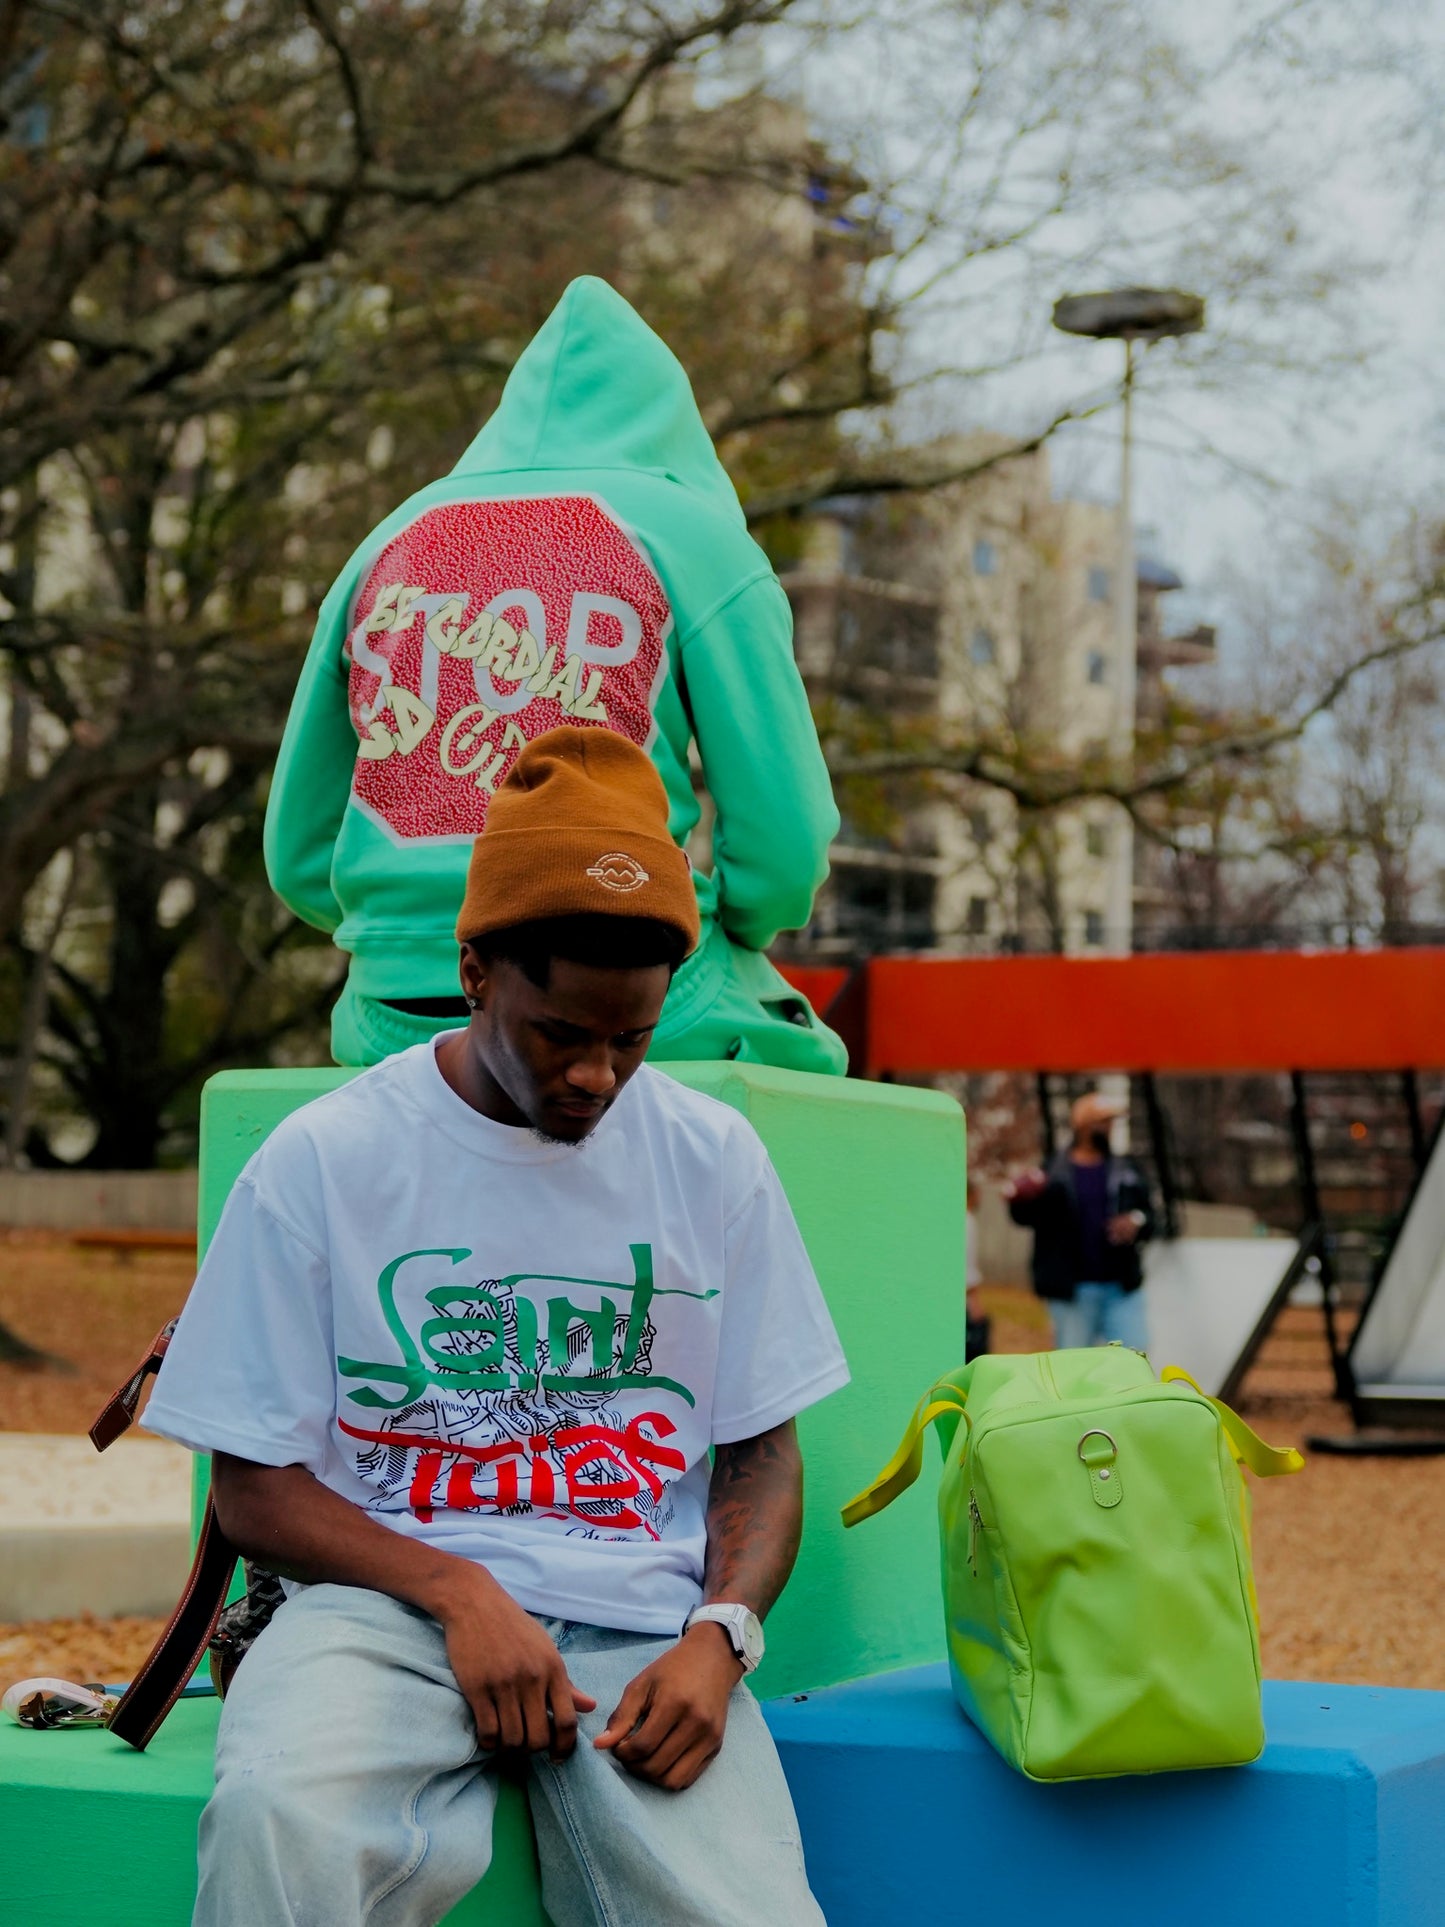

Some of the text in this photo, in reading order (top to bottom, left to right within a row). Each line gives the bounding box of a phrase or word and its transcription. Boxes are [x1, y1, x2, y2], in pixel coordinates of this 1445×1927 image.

[352, 588, 643, 727] STOP
[364, 582, 427, 634] BE
[337, 1243, 721, 1409] Saint
